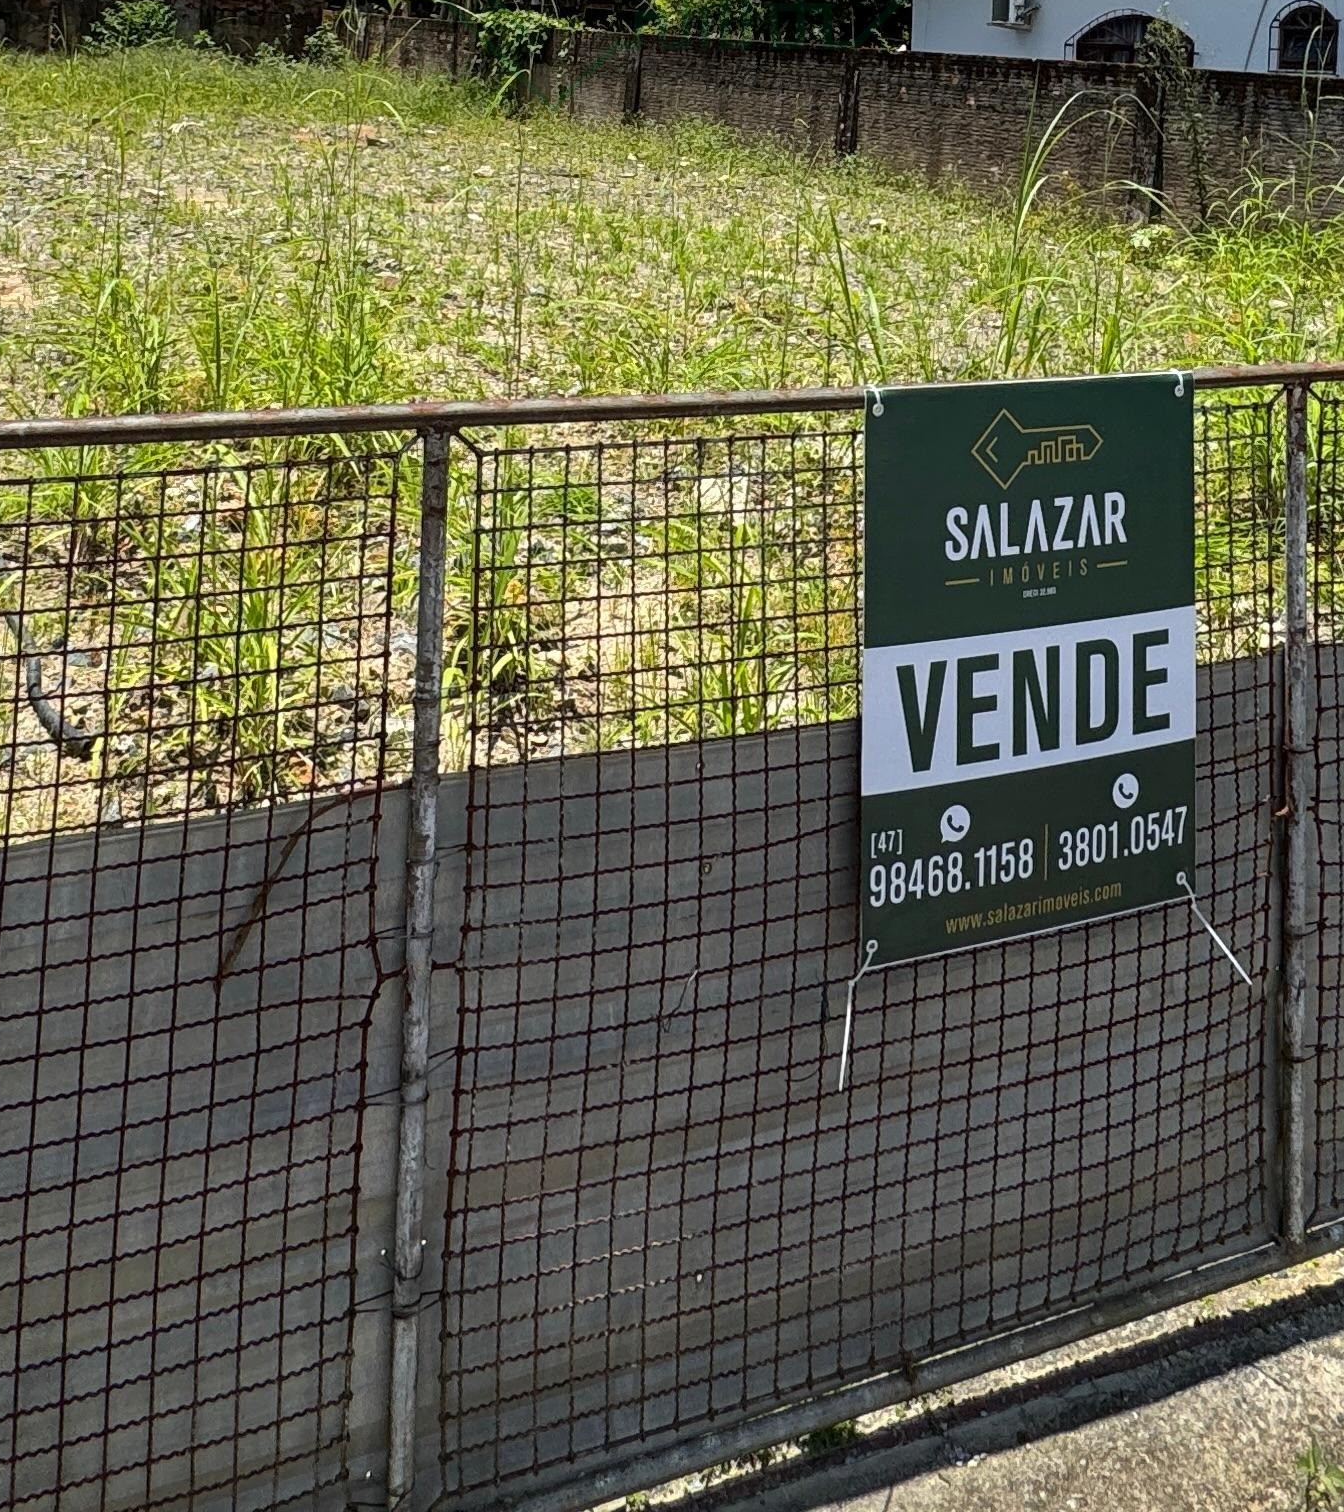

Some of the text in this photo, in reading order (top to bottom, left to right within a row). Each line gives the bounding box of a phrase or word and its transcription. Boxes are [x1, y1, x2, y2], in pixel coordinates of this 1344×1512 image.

[945, 491, 1127, 561] SALAZAR
[989, 560, 1089, 586] IMÓVEIS
[896, 628, 1170, 773] VENDE
[869, 806, 1188, 908] 98468.1158 3801.0547
[945, 882, 1122, 934] www.salazarimoveis.com
